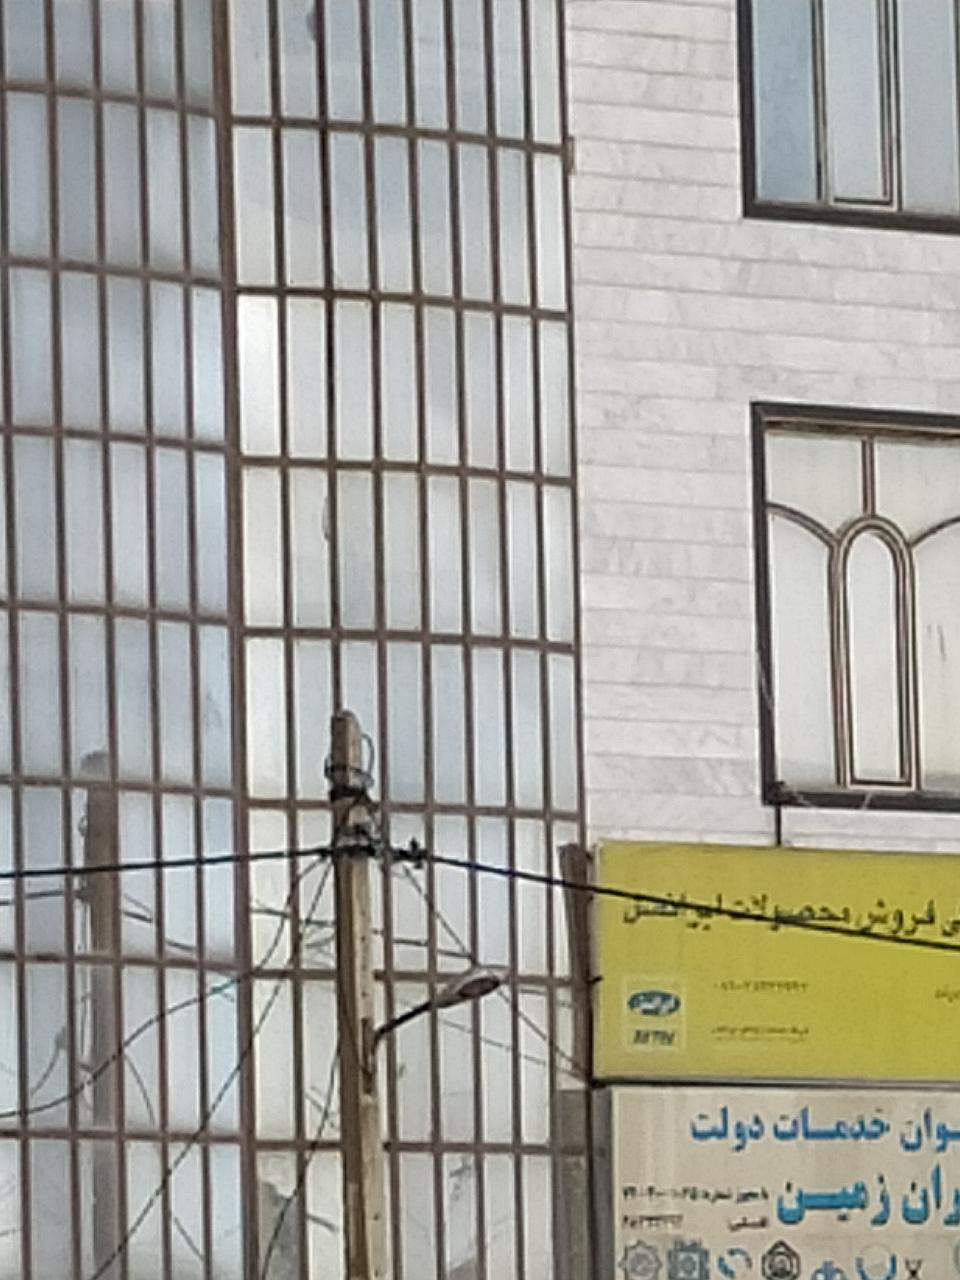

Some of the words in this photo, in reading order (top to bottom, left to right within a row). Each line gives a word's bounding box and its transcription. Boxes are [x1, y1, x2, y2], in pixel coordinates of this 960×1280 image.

[855, 898, 935, 936] فروش
[690, 1105, 766, 1153] دولت
[772, 1105, 891, 1141] خدمات
[776, 1173, 891, 1227] زمین
